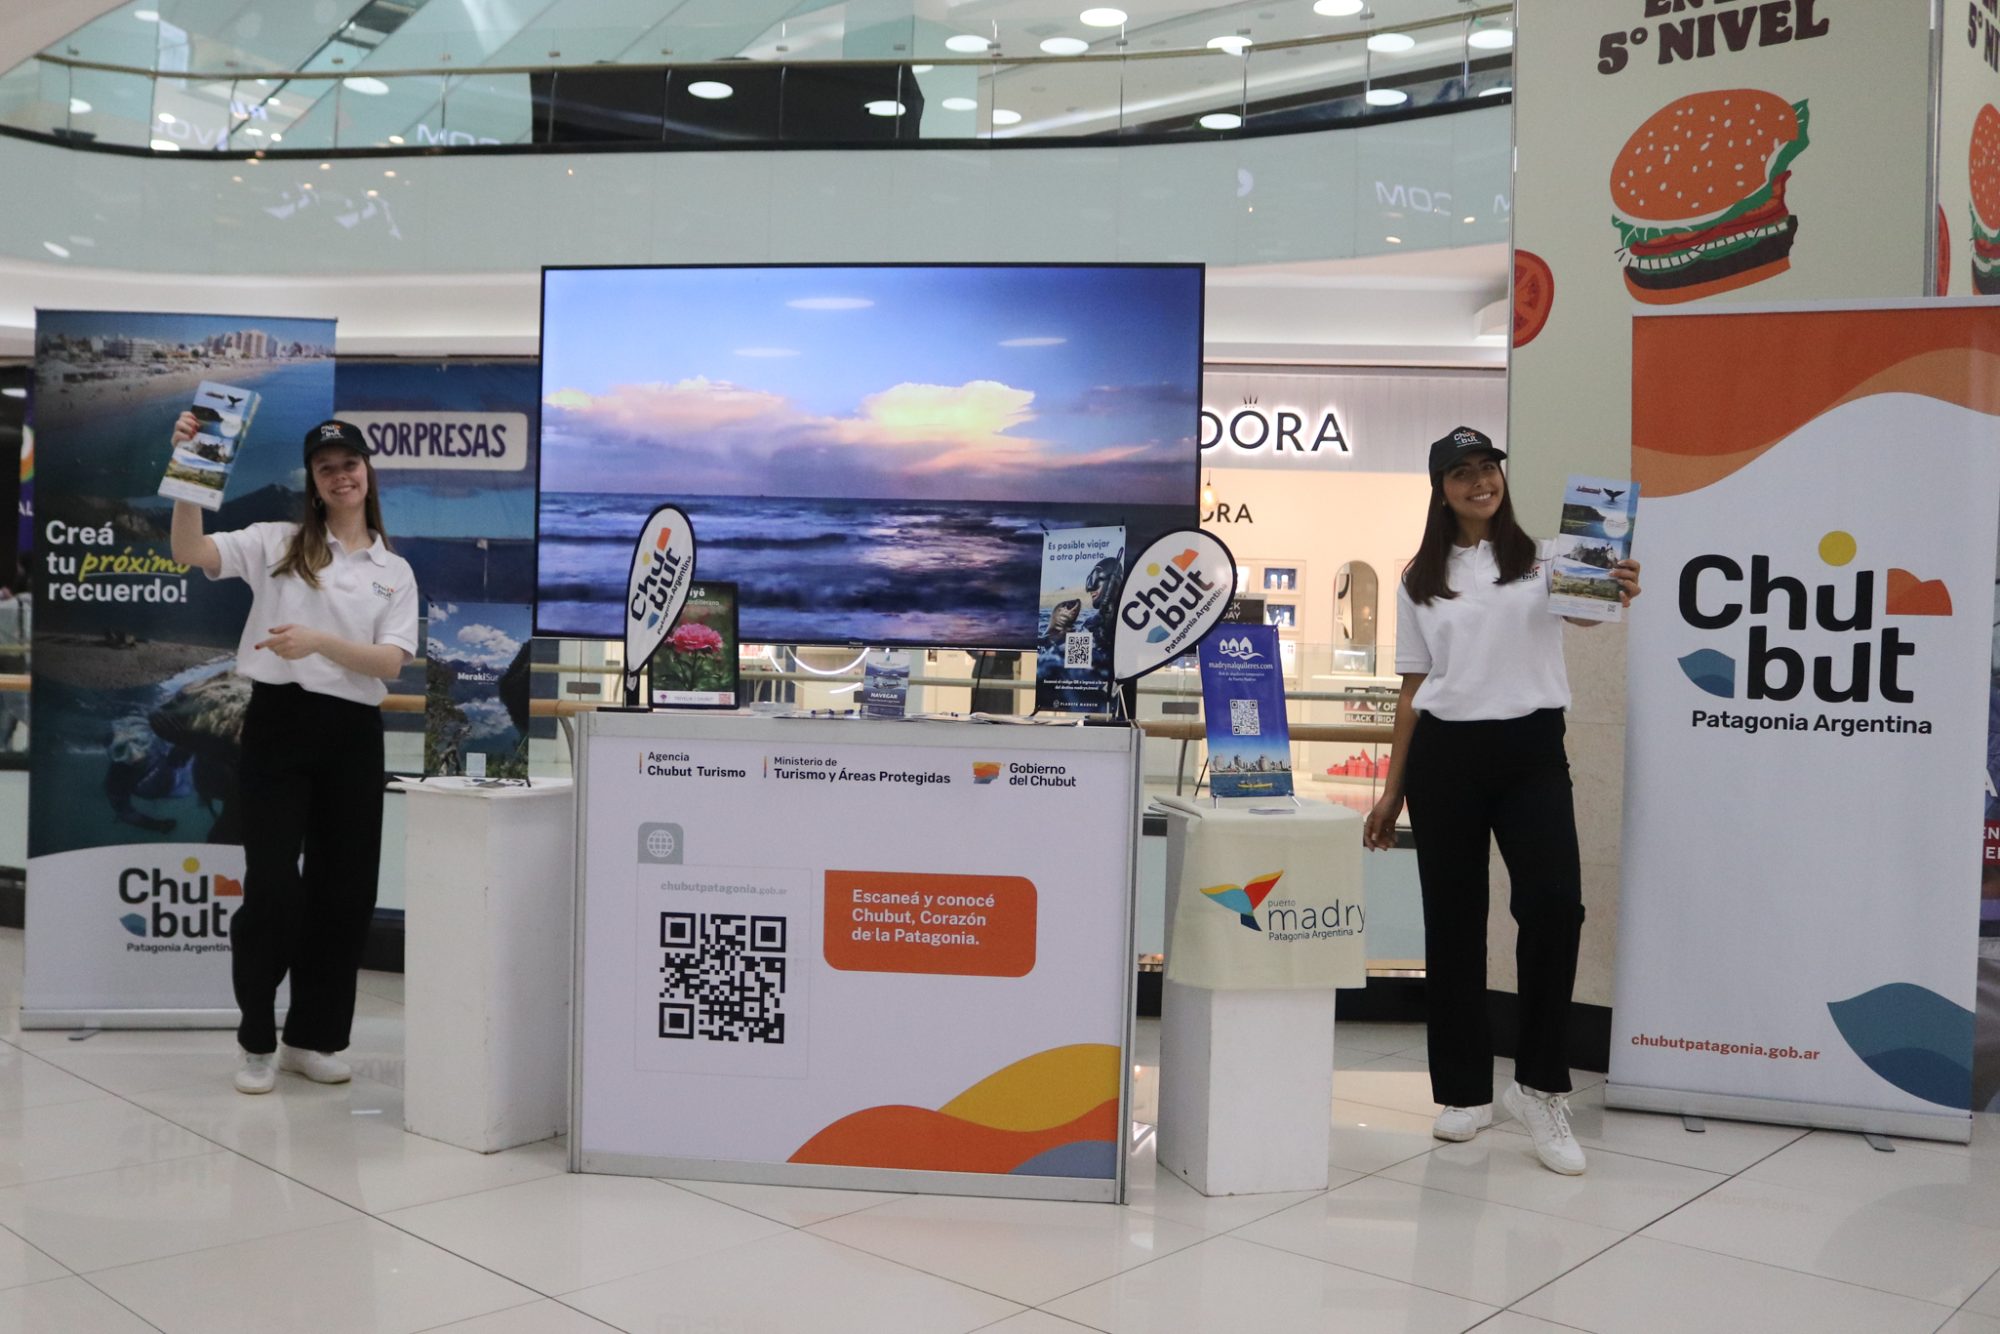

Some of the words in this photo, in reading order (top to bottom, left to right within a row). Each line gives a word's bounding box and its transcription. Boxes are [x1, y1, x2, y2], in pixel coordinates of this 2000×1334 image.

[1657, 0, 1830, 65] NIVEL
[367, 422, 507, 458] SORPRESAS
[46, 520, 114, 546] Creá
[1048, 542, 1056, 550] Es
[1057, 541, 1085, 551] posible
[1087, 540, 1110, 551] viajar
[46, 551, 76, 575] tu
[671, 555, 692, 596] Argentina
[48, 577, 188, 603] recuerdo!
[630, 550, 666, 622] Chu
[1121, 564, 1185, 631] Chu
[1679, 554, 1874, 632] Chu
[1155, 570, 1215, 631] but
[1165, 618, 1198, 654] Patagonia
[1196, 583, 1228, 619] Argentina
[1747, 625, 1915, 703] but
[1692, 710, 1808, 734] Patagonia
[1813, 714, 1932, 737] Argentina
[648, 752, 690, 762] Agencia
[774, 756, 823, 766] Ministerio
[825, 757, 837, 766] de
[1009, 762, 1066, 775] Gobierno
[647, 765, 692, 776] Chubut
[696, 766, 746, 778] Turismo
[774, 768, 826, 780] Turismo
[828, 771, 837, 782] y
[838, 767, 876, 781] Áreas
[879, 771, 951, 786] Protegidas
[1009, 775, 1028, 786] del
[1030, 775, 1077, 787] Chubut
[119, 867, 208, 905] Chu
[661, 881, 787, 895] chubutpatagonia.gob.ar
[852, 889, 920, 905] Escaneá
[923, 894, 933, 908] y
[937, 893, 995, 908] conocé
[1268, 899, 1296, 907] puerto
[152, 902, 228, 938] but
[852, 908, 916, 925] Chubut,
[920, 911, 986, 926] Corazón
[851, 927, 871, 941] de
[875, 928, 890, 942] la
[894, 928, 980, 947] Patagonia.
[1268, 930, 1310, 942] Patagonia
[1311, 928, 1354, 940] Argentina
[127, 943, 181, 954] Patagonia
[1631, 1033, 1820, 1060] chubutpatagonia.gob.ar
